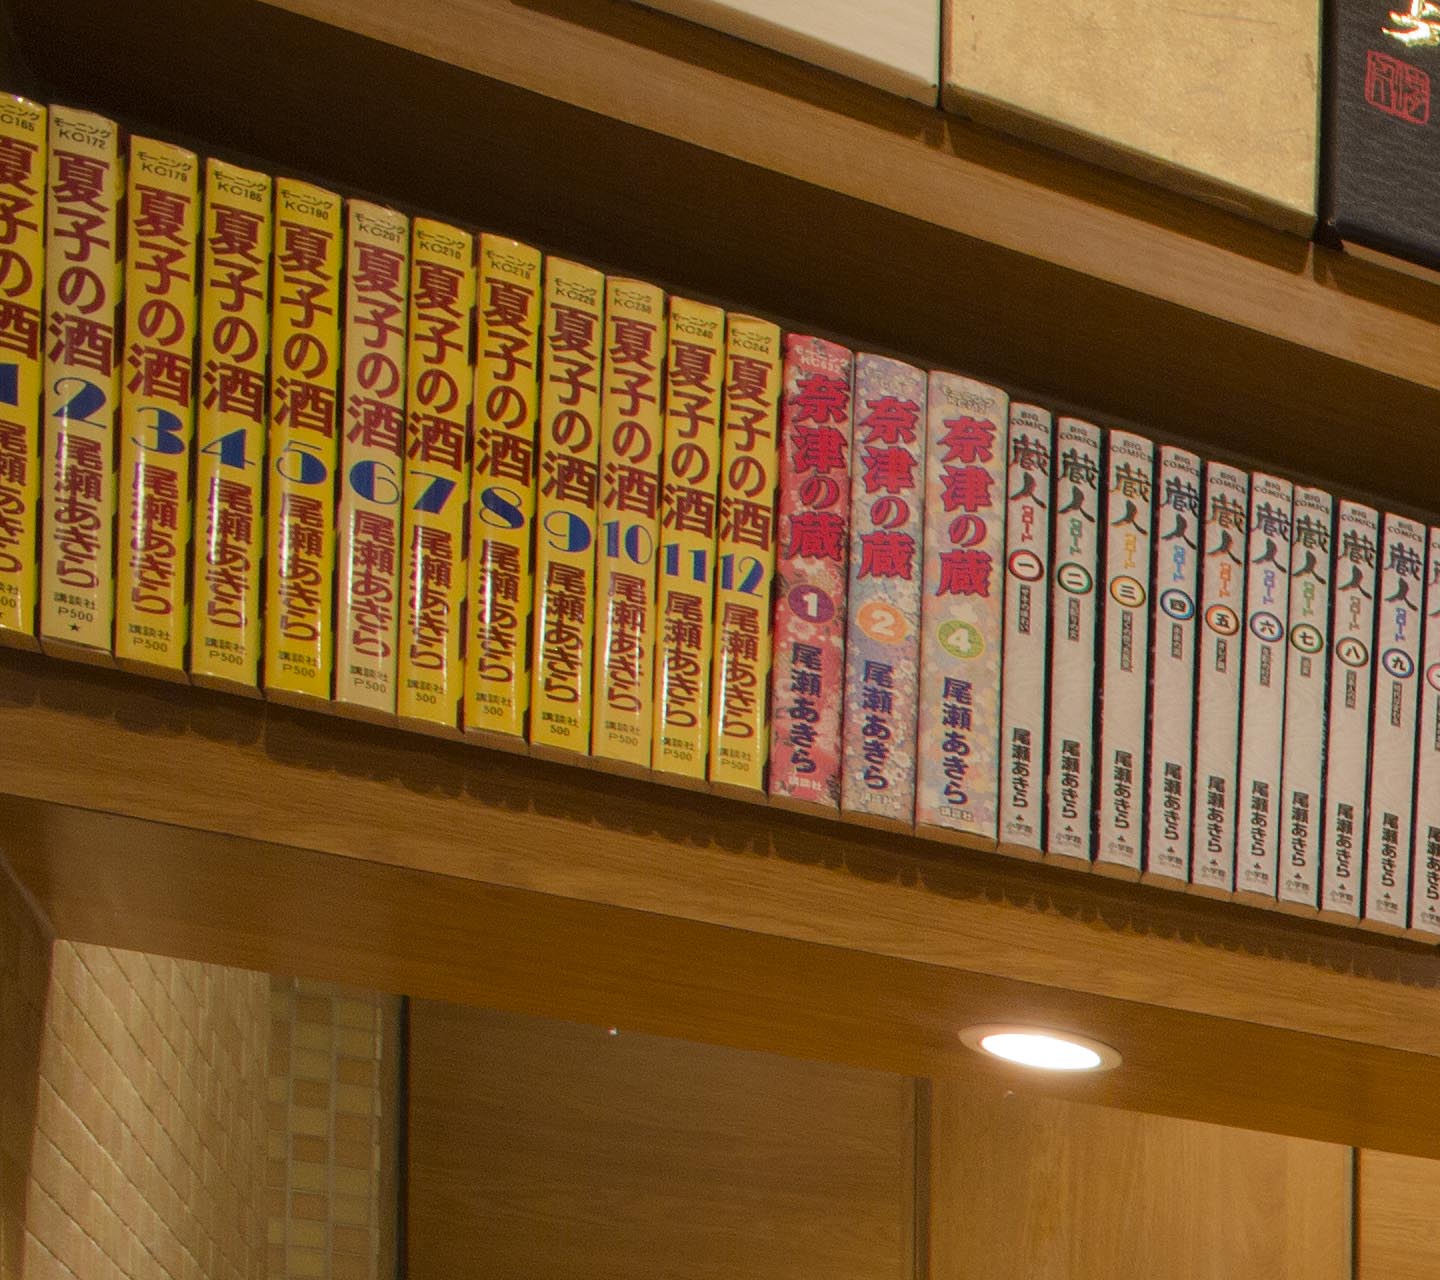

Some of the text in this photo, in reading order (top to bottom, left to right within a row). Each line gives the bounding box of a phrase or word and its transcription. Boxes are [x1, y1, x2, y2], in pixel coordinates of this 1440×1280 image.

[48, 149, 112, 377] 夏子の酒
[127, 183, 190, 407] 夏子の酒
[204, 203, 265, 425] 夏子の酒
[273, 220, 335, 439] 夏子の酒
[348, 240, 405, 459] 夏子の酒
[720, 354, 773, 553] 夏子の酒
[788, 373, 848, 562] 奈津の蔵
[856, 396, 919, 582] 奈津の蔵
[935, 415, 996, 598] 奈津の蔵
[1010, 433, 1048, 510] 蔵人
